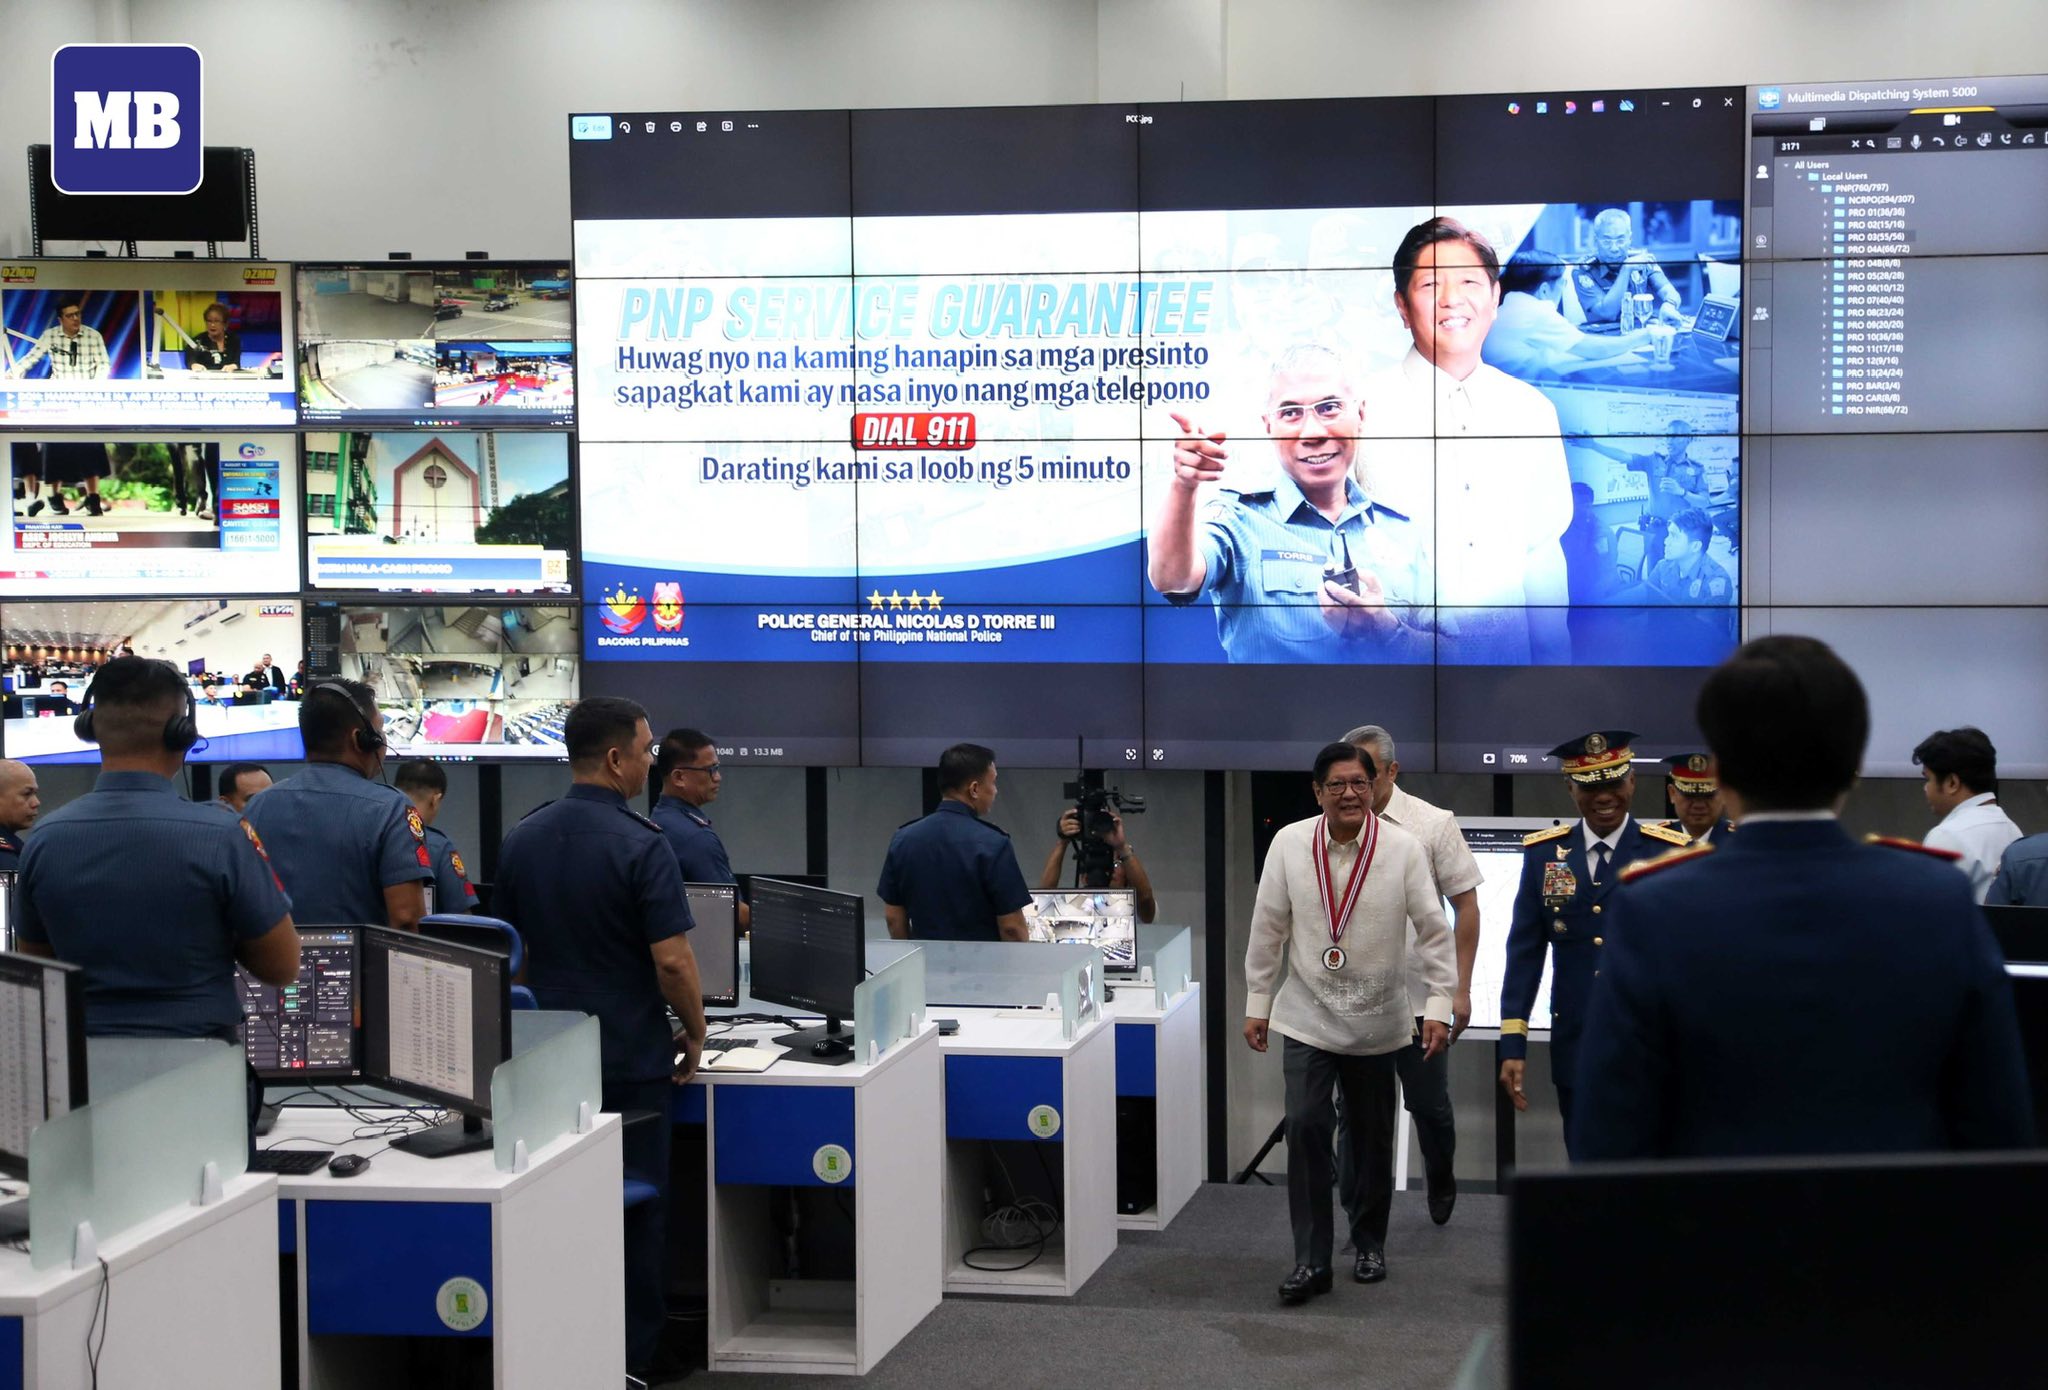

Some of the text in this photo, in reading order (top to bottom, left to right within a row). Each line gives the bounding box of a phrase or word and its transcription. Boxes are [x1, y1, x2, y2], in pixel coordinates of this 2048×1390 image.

[1787, 86, 1978, 103] Multimedia Dispatching System 5000
[1781, 142, 1800, 151] 3171
[1794, 160, 1830, 169] All Users
[1822, 171, 1868, 181] Local Users
[1848, 208, 1866, 217] PRO
[1848, 220, 1865, 229] PRO
[1848, 232, 1865, 242] PRO
[1848, 244, 1865, 254] PRO
[1848, 259, 1865, 268] PRO
[1848, 272, 1865, 281] PRO
[1848, 284, 1865, 293] PRO
[1848, 296, 1864, 305] PRO
[617, 281, 1214, 341] PNP SERVICE GUARANTEE
[1848, 308, 1864, 317] PRO
[1847, 320, 1864, 330] PRO
[1847, 332, 1864, 342] PRO
[1847, 344, 1864, 354] PRO
[618, 341, 1209, 375] Huwag nyo na kaming hanapin sa mga presinto
[1846, 356, 1864, 366] PRO
[1846, 368, 1864, 378] PRO
[1846, 382, 1864, 391] PRO
[617, 375, 1210, 409] sapagkat kami ay nasa inyo nang mga telepono
[1846, 394, 1864, 403] PRO
[1846, 406, 1864, 416] PRO
[861, 416, 969, 446] DIAL 911
[702, 455, 1131, 487] Darating kami sa loob ng 5 minuto
[1277, 551, 1314, 562] TORRE
[758, 614, 1056, 629] POLICE GENERAL NICOLAS D TORRE III
[598, 637, 690, 647] BAGONG PILIPINAS
[810, 629, 1003, 645] Chief of the Philippine National Police
[716, 747, 784, 756] 1040 13.3 MB
[1510, 754, 1528, 764] 70%
